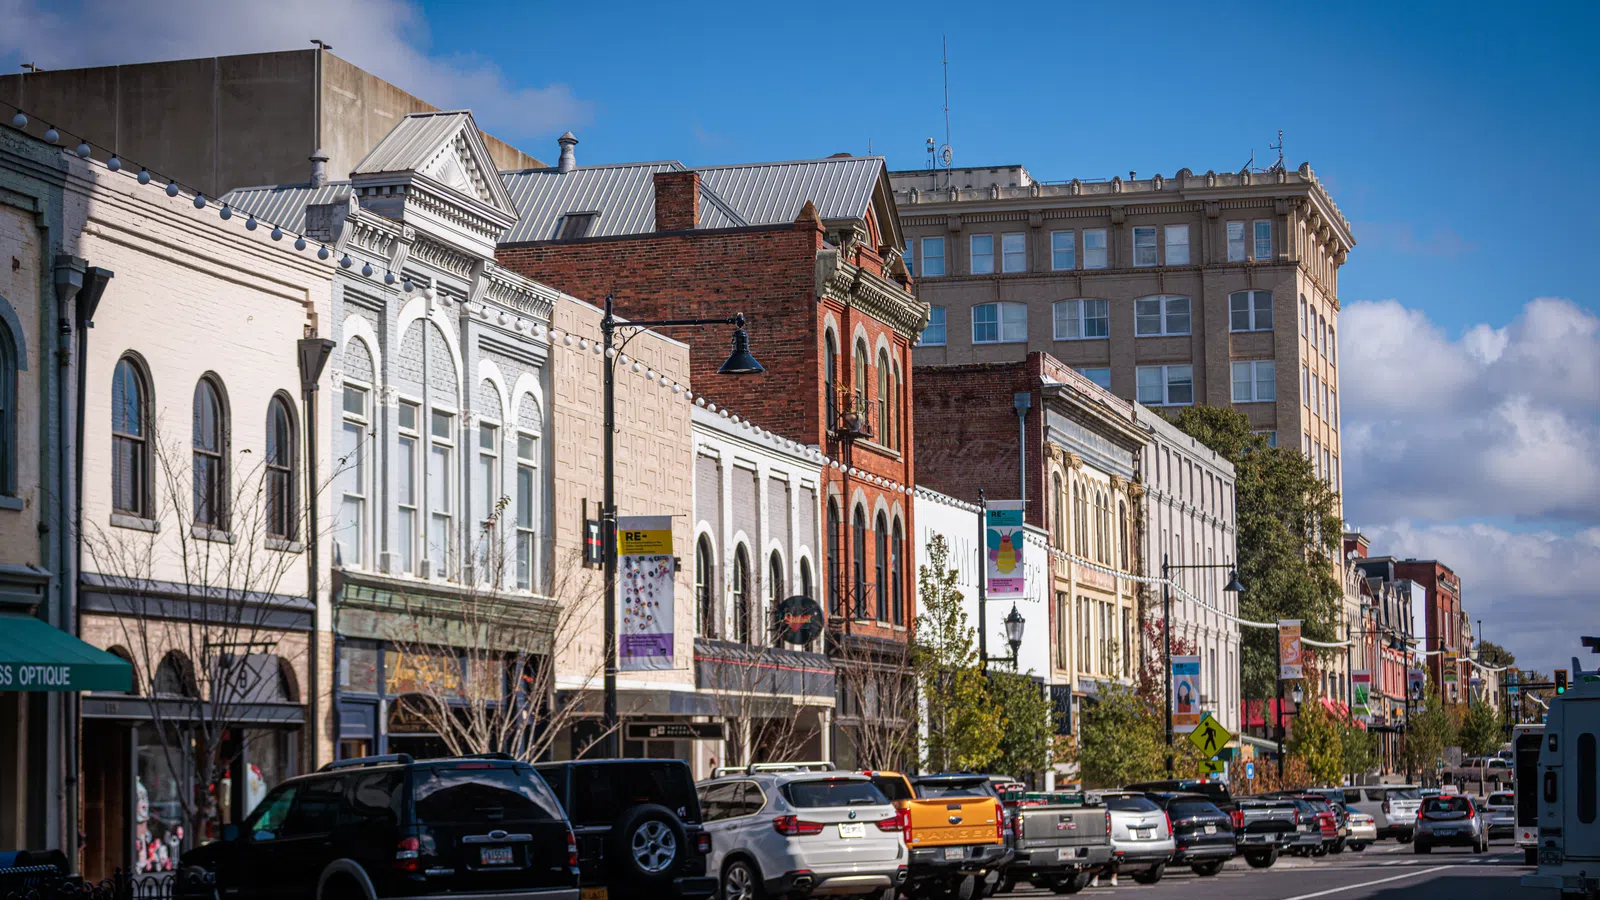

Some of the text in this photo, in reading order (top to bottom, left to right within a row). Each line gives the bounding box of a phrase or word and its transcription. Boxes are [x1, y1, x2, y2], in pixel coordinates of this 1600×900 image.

[625, 531, 647, 541] RE-
[18, 665, 71, 686] OPTIQUE
[1056, 822, 1077, 831] GMC
[914, 828, 996, 840] RANGER
